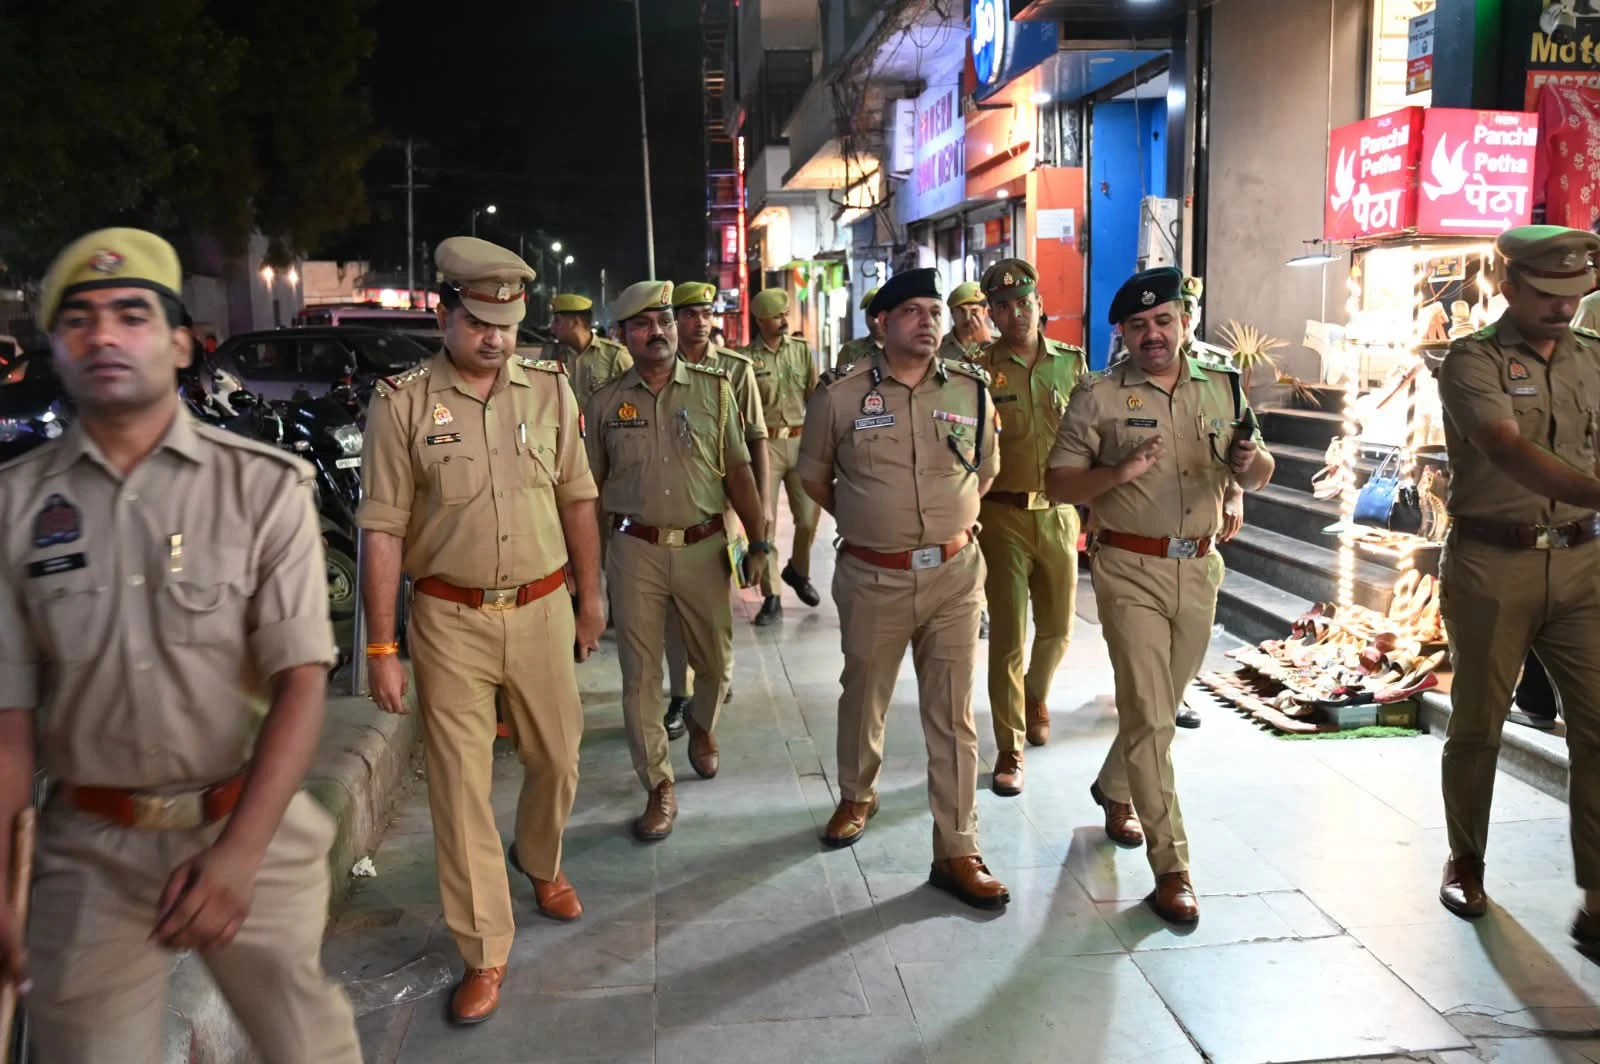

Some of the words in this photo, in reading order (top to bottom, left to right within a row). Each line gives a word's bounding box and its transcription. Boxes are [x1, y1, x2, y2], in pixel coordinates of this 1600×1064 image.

[1361, 153, 1402, 178] Petha
[1474, 152, 1527, 173] Petha
[1464, 172, 1528, 216] पेठा
